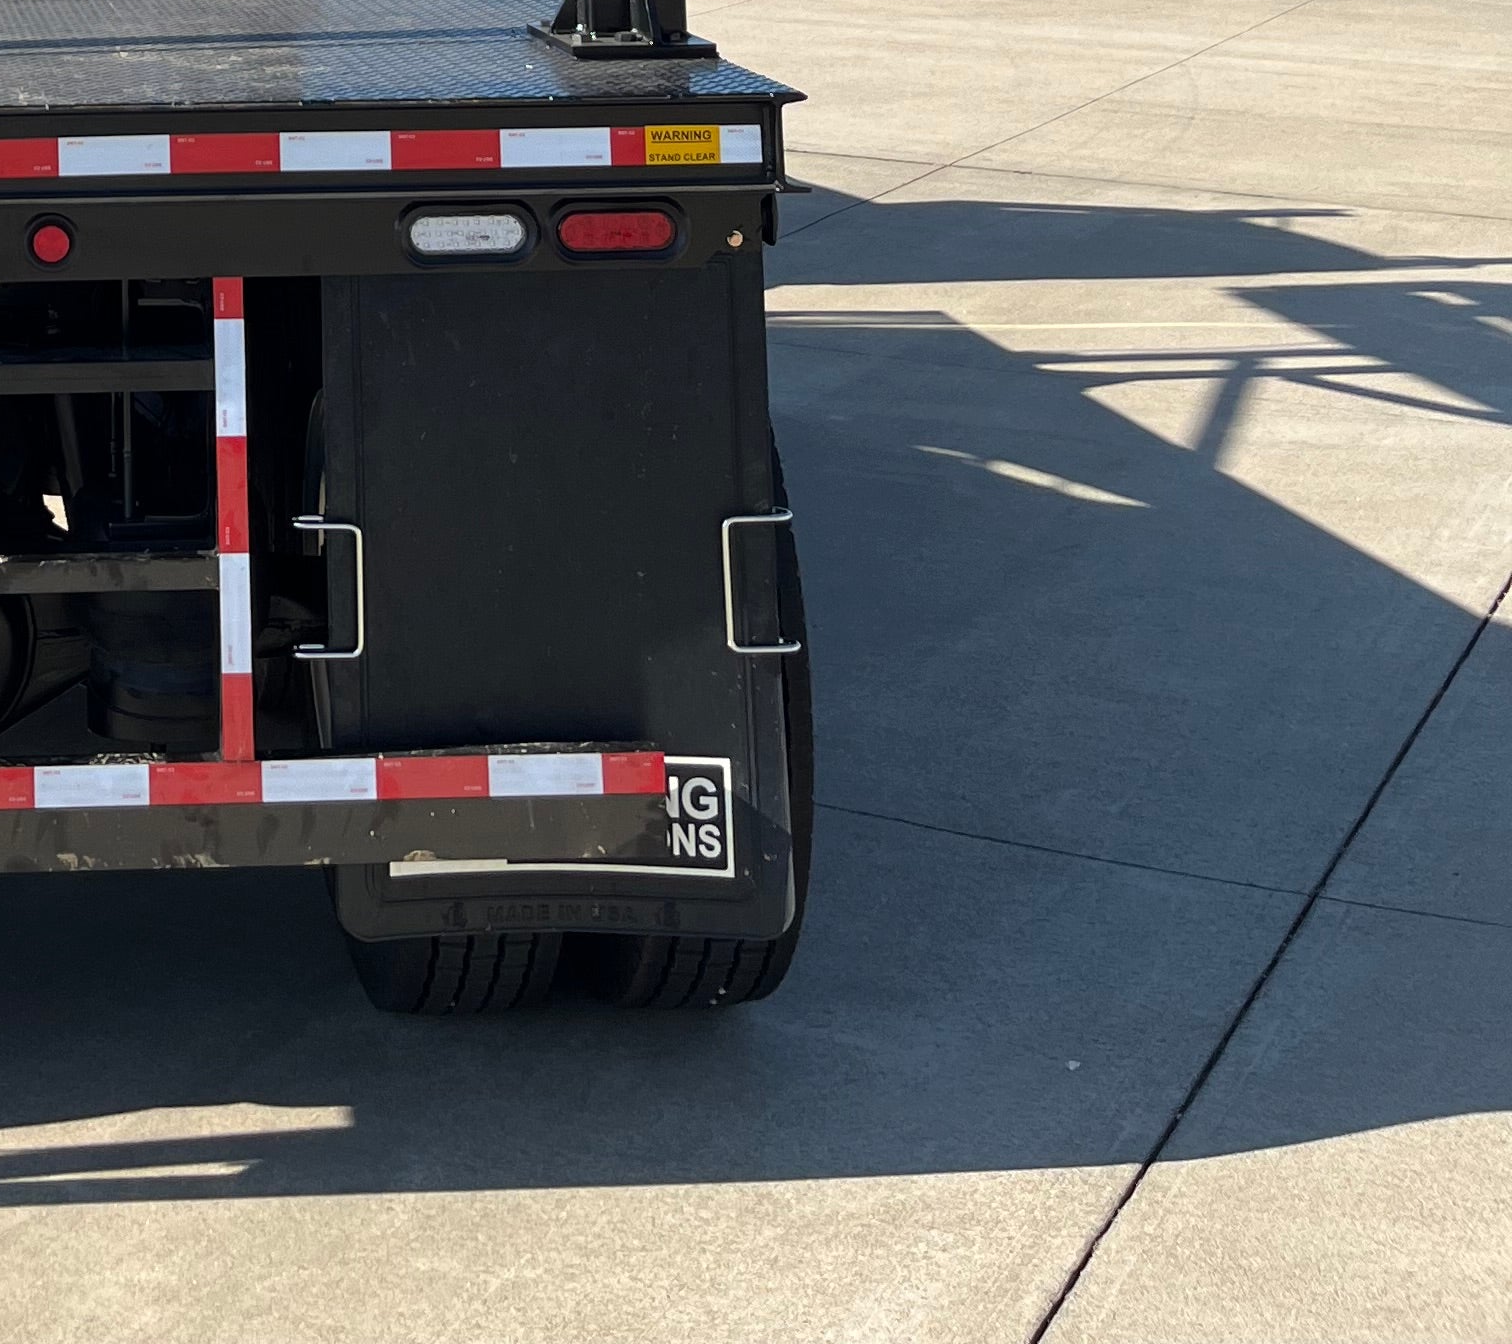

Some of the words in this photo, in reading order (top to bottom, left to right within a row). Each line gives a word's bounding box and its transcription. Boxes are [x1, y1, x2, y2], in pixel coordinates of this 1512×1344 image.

[651, 130, 712, 141] WARNING
[649, 153, 681, 162] STAND
[684, 152, 715, 161] CLEAR
